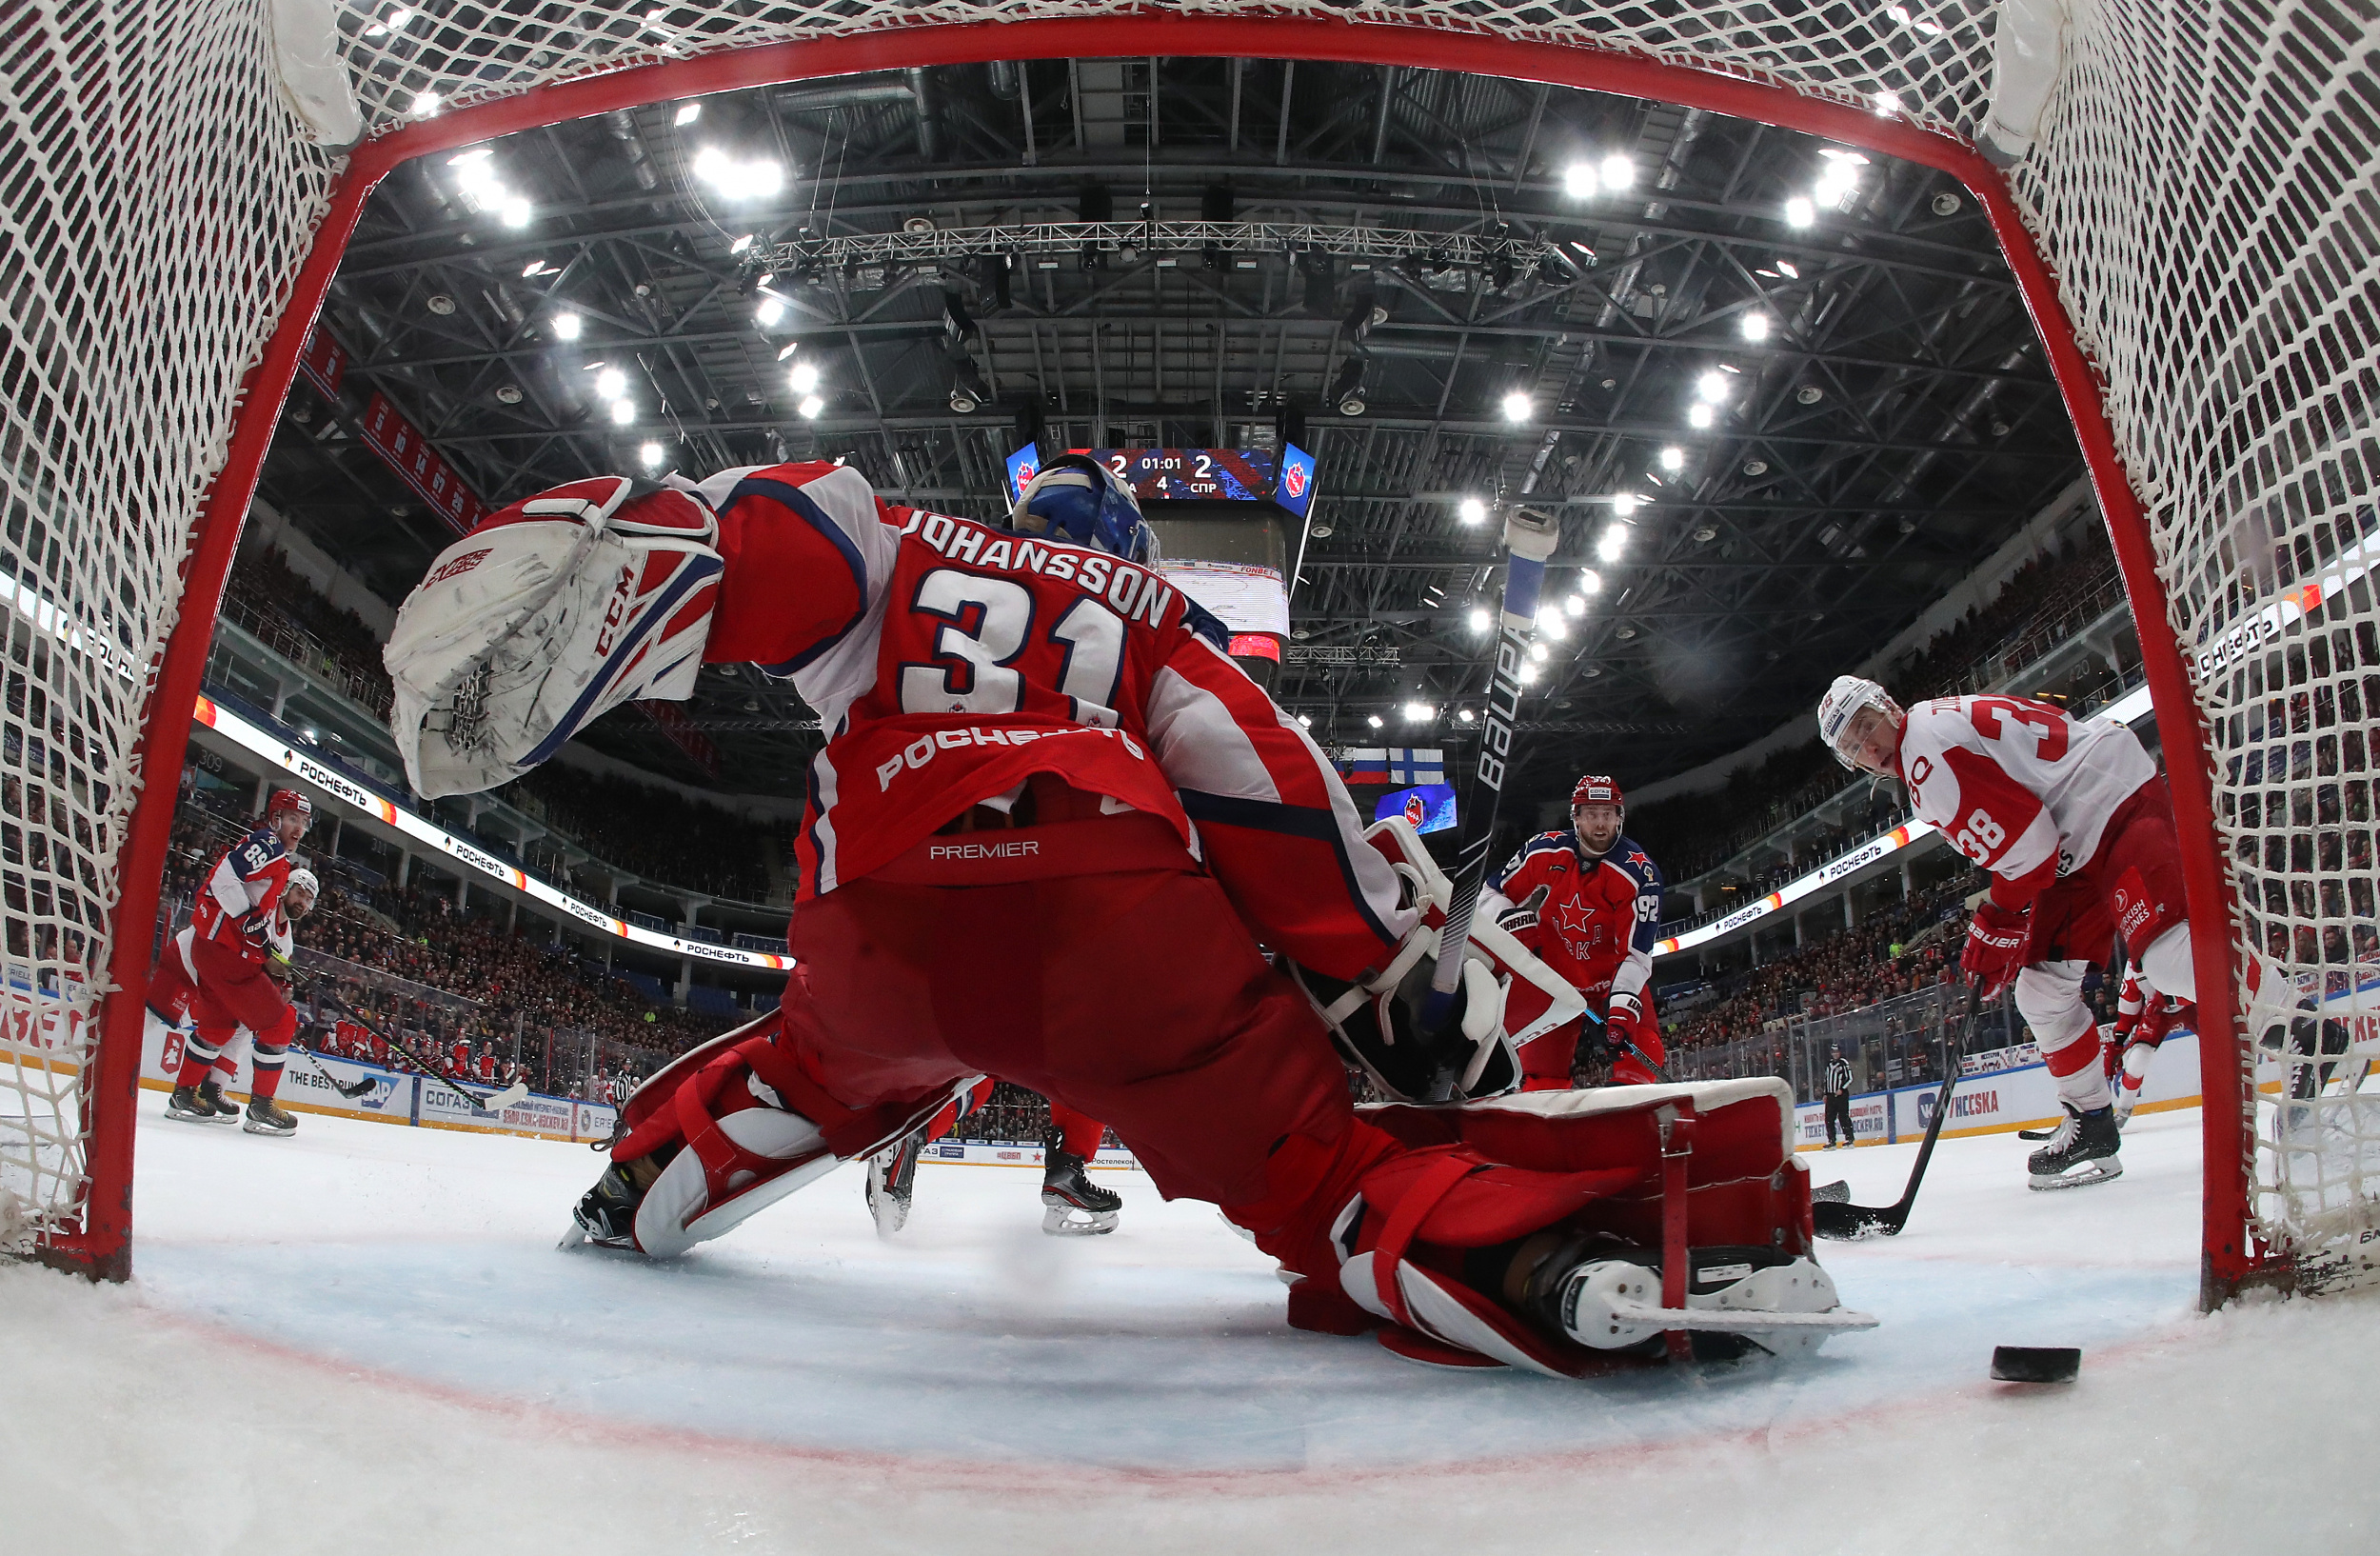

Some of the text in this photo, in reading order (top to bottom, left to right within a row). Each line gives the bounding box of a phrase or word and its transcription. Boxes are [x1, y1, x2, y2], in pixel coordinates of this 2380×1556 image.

[1110, 454, 1213, 479] 2 01:01 2
[1157, 476, 1168, 490] 4
[1190, 483, 1217, 493] СПР
[901, 510, 1172, 629] JOHANSSON
[1240, 566, 1275, 577] FONBET
[594, 565, 635, 657] CCM
[897, 567, 1127, 728] 31
[1824, 708, 1840, 733] СОГАЗ
[1972, 693, 2069, 762] 3
[199, 748, 223, 772] 309
[300, 761, 367, 807] РОСНЕФТЬ
[1957, 808, 2006, 866] 38
[243, 843, 268, 870] 89
[456, 844, 506, 877] РОСНЕФТЬ
[930, 841, 1040, 860] PREMIER
[1830, 846, 1882, 878] РОСНЕФТЬ
[570, 903, 607, 928] РОСНЕФТЬ
[1636, 894, 1659, 923] 92
[1723, 906, 1762, 930] РОСНЕФТЬ
[1968, 921, 2020, 948] BAUER
[687, 944, 750, 963] РОСНЕФТЬ
[288, 1070, 308, 1086] THE
[426, 1089, 470, 1109] СОГАЗ
